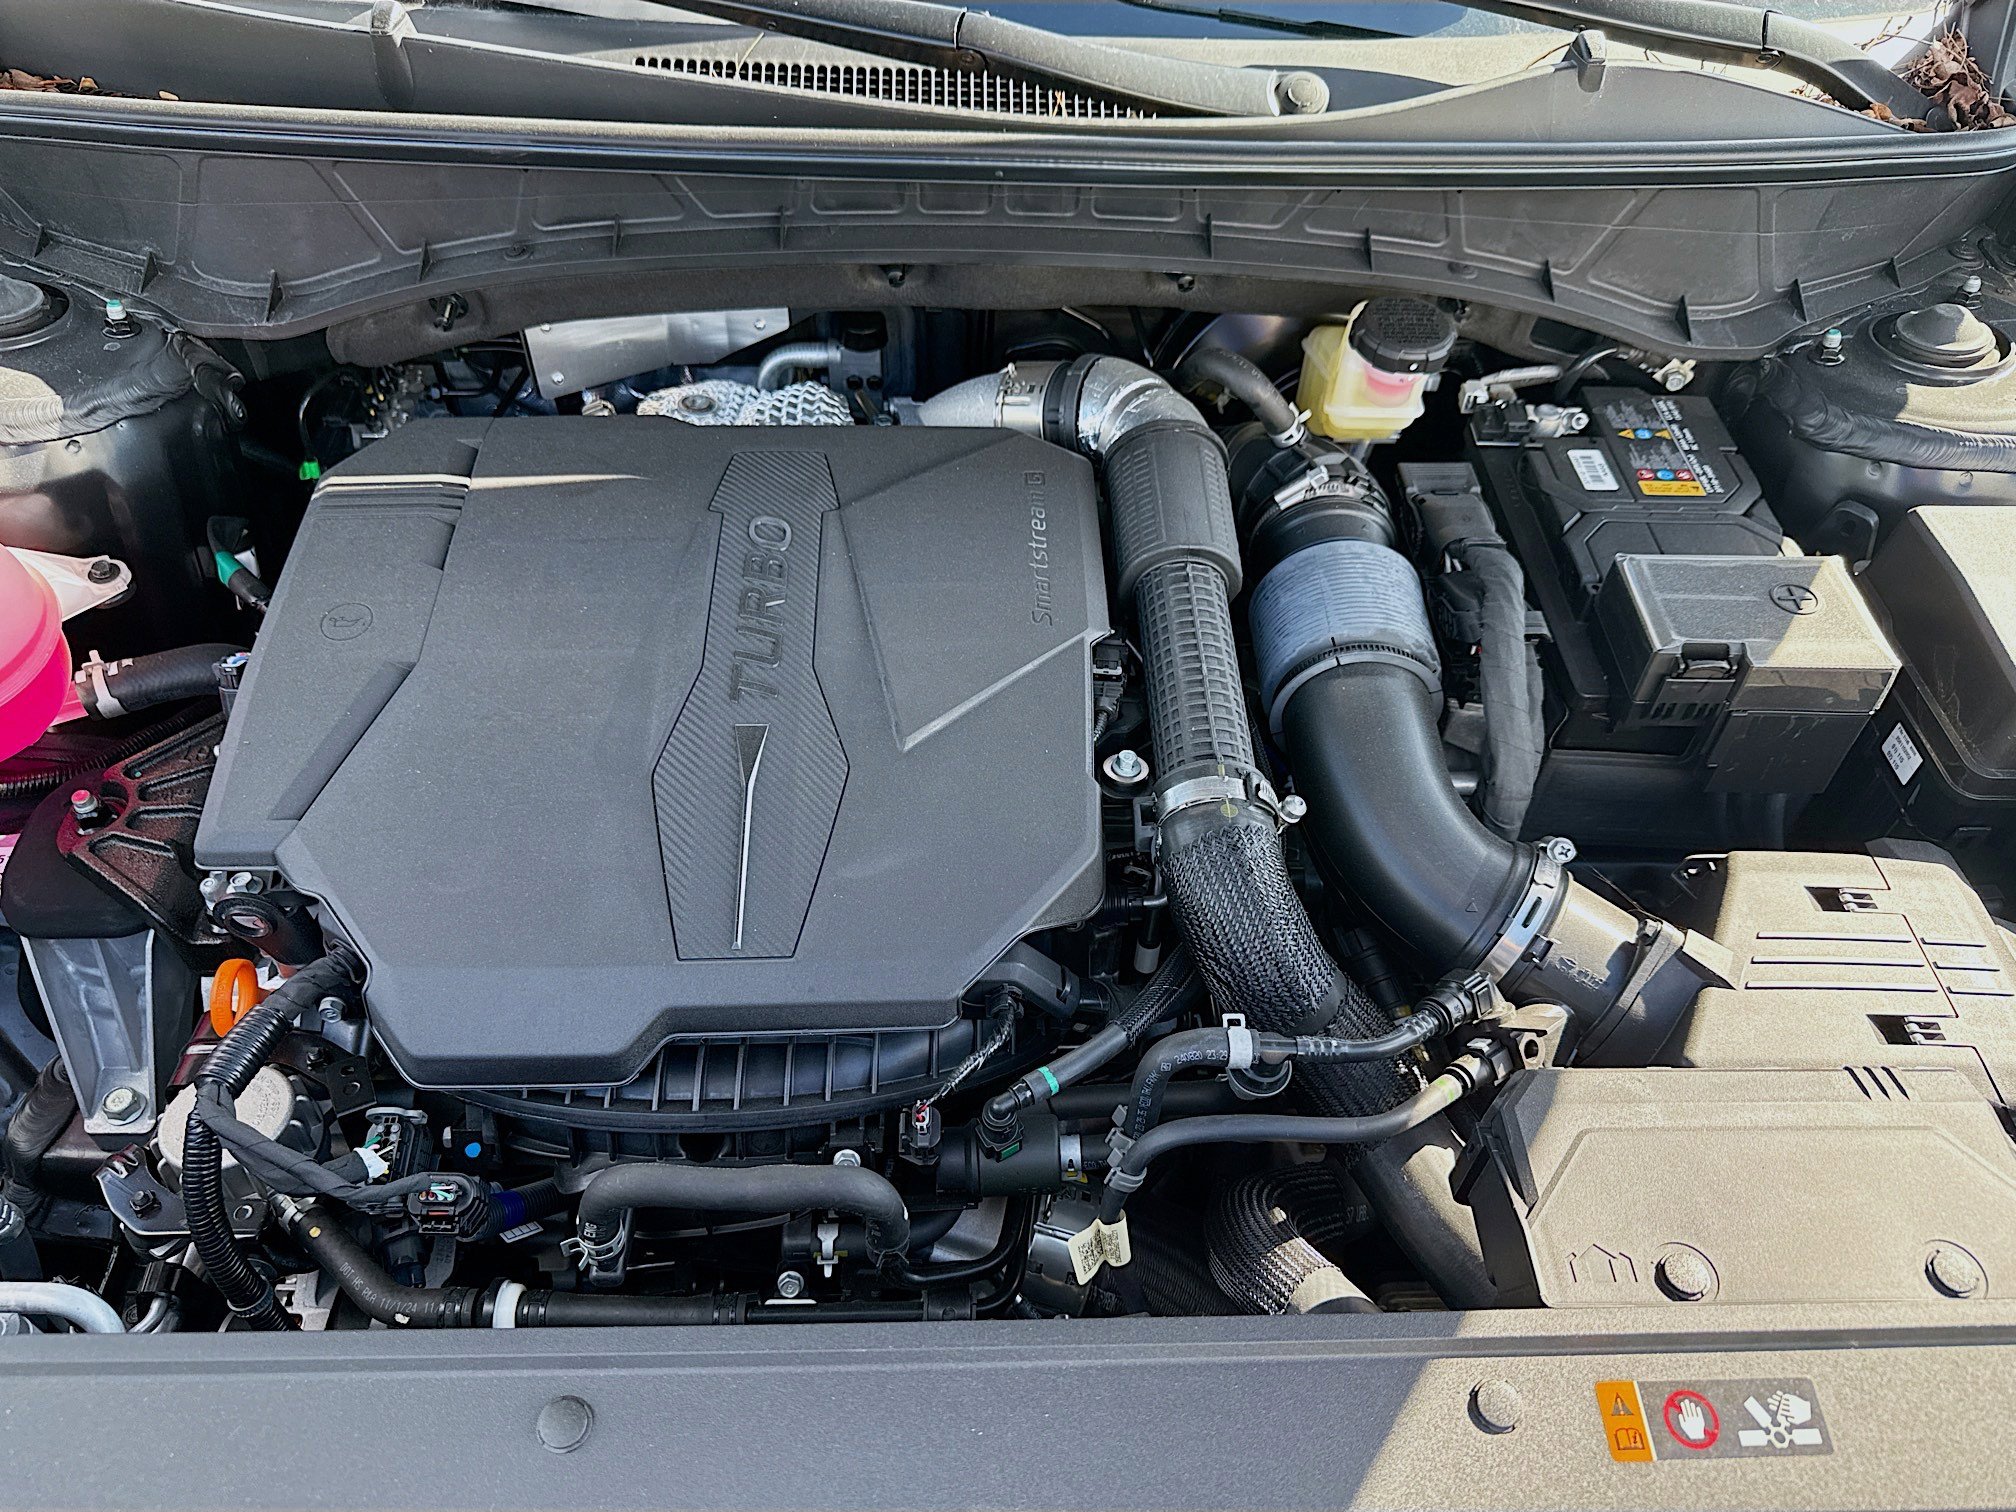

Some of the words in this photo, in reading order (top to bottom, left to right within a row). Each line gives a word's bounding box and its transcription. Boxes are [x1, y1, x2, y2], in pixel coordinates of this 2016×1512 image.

[1028, 490, 1053, 627] Smartstream
[729, 515, 792, 704] TURBO
[583, 1222, 598, 1238] ENG
[339, 1261, 354, 1279] DOT
[352, 1276, 364, 1291] HS
[379, 1297, 417, 1312] 11/1/24
